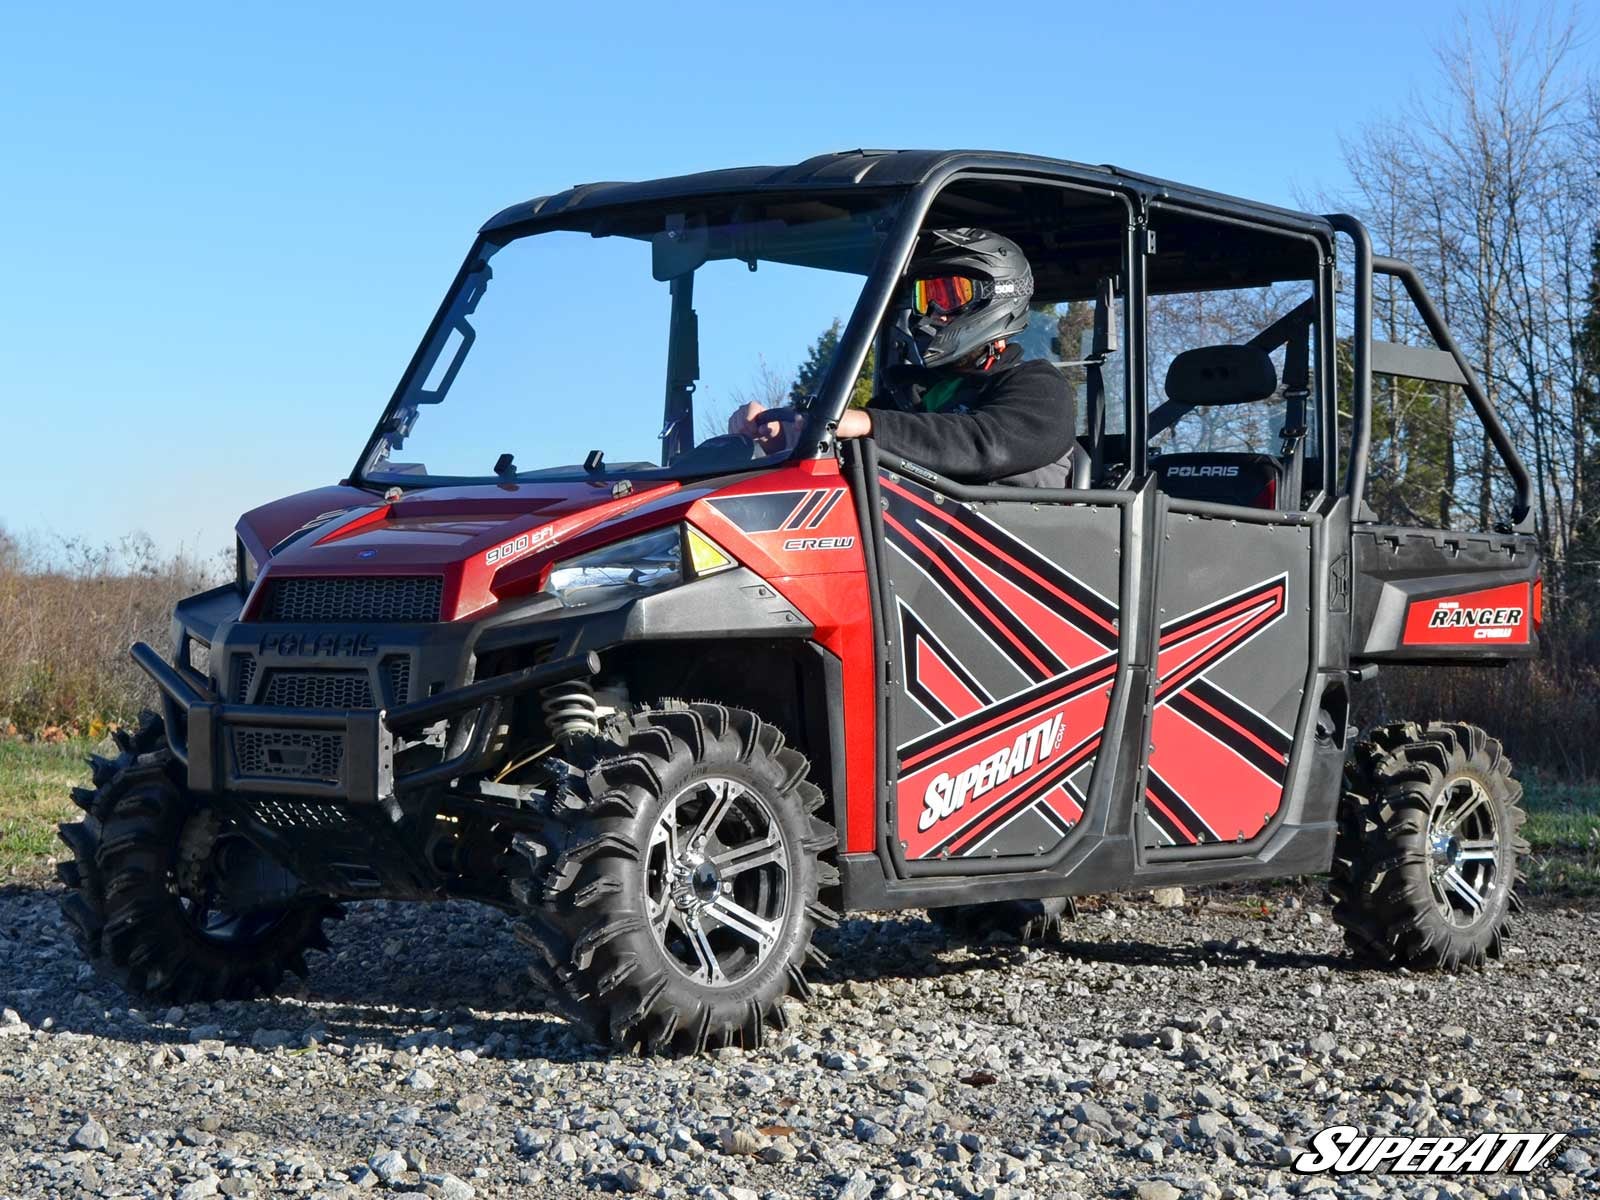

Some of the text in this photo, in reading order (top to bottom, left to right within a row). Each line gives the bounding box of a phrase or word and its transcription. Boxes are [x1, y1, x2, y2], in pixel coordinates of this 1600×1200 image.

[1167, 466, 1239, 477] POLARIS
[486, 534, 529, 566] 900
[783, 536, 855, 551] CREW
[1428, 608, 1523, 628] RANGER
[258, 632, 378, 657] POLARIS
[917, 711, 1065, 833] SUPERATV
